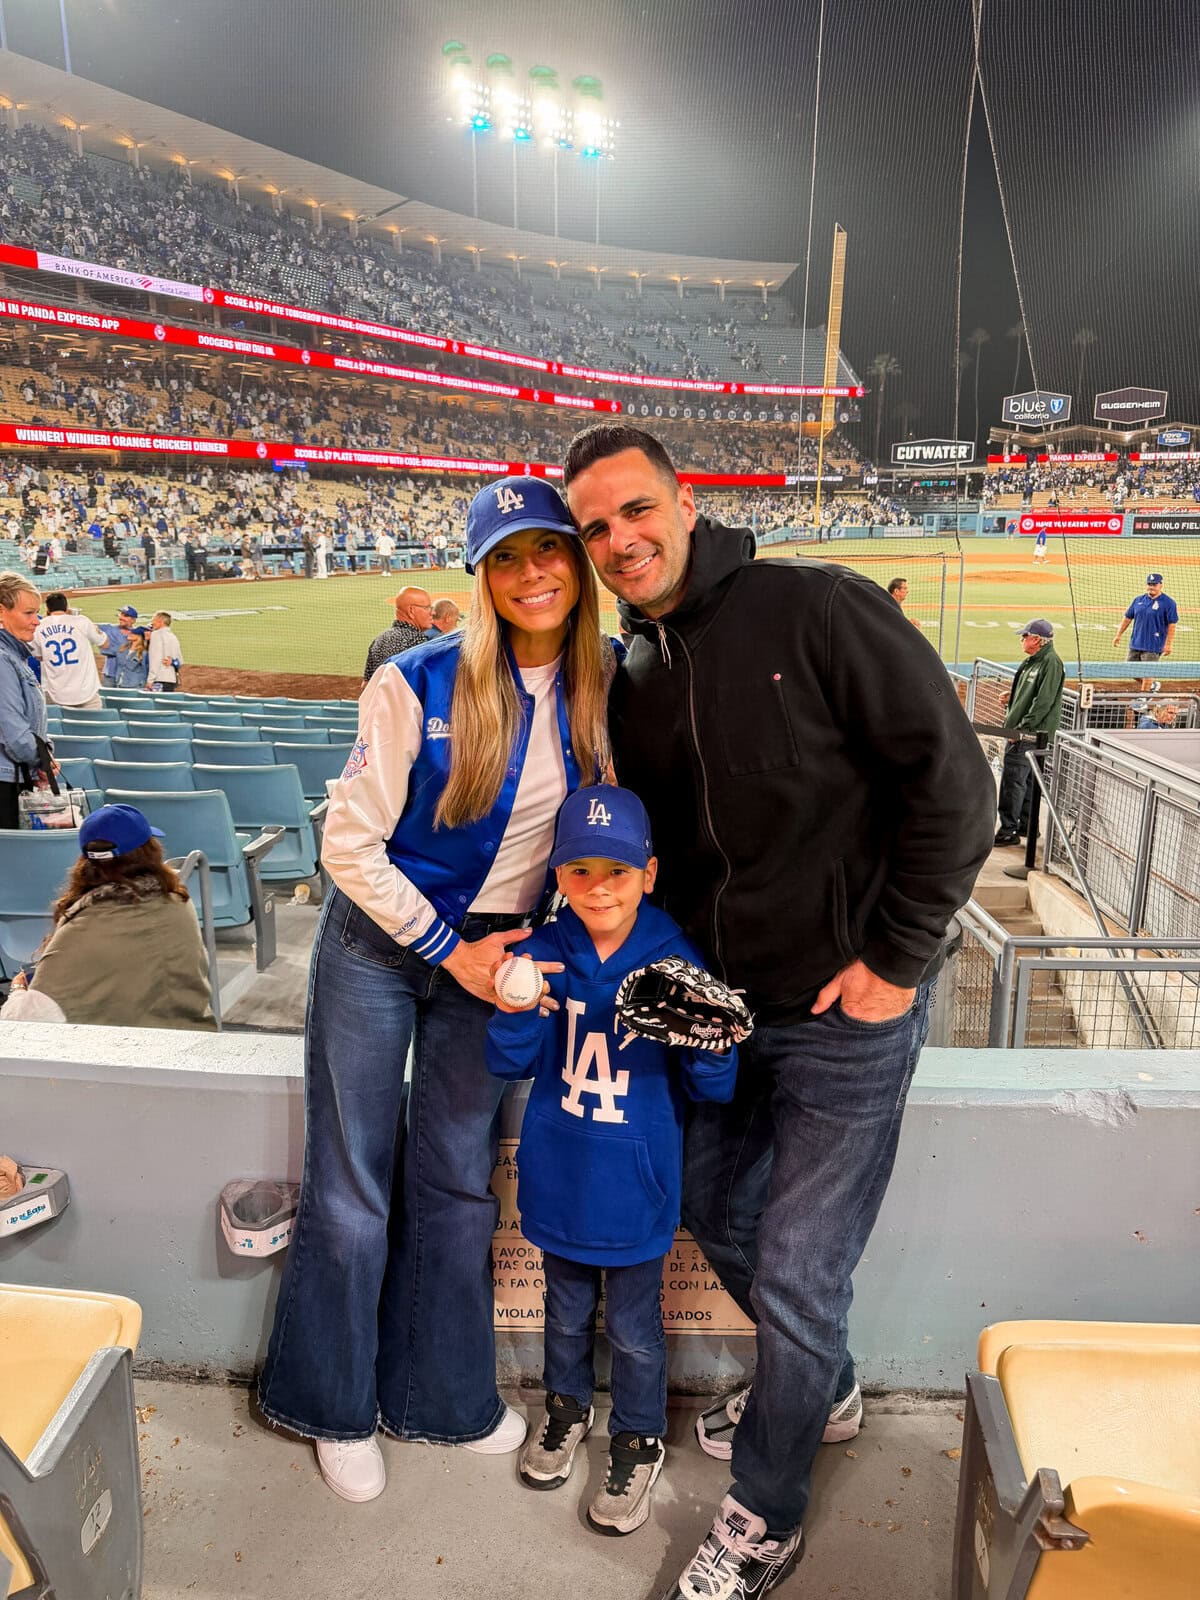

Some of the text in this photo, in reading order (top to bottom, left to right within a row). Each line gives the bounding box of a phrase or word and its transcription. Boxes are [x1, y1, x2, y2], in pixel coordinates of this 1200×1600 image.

[55, 263, 135, 286] BANK OF AMERICA
[224, 295, 248, 308] SCORE
[248, 299, 255, 309] A
[254, 300, 263, 311] $7
[263, 303, 285, 316] PLATE
[8, 302, 19, 314] IN
[21, 304, 56, 320] PANDA
[57, 311, 100, 327] EXPRESS
[101, 319, 119, 330] APP
[198, 334, 234, 349] DODGERS
[1009, 398, 1046, 413] blue
[1101, 401, 1160, 409] GUGGENHEIM
[1014, 412, 1050, 420] californa
[16, 429, 228, 453] WINNER! WINNER! ORANGE CHICKEN DINNER!
[294, 448, 319, 459] SCORE
[333, 451, 353, 461] PLATE
[897, 445, 967, 460] CUTWATER
[1050, 453, 1105, 461] PANDA EXPRESS
[494, 486, 525, 514] LA
[1151, 522, 1180, 530] UNIQLO
[40, 624, 75, 639] KOUFAX
[45, 638, 79, 667] 32
[586, 798, 612, 826] LA
[561, 996, 630, 1124] LA
[670, 1262, 685, 1272] DE
[669, 1280, 699, 1290] CON
[704, 1280, 727, 1290] LAS
[729, 1511, 749, 1528] NIKE
